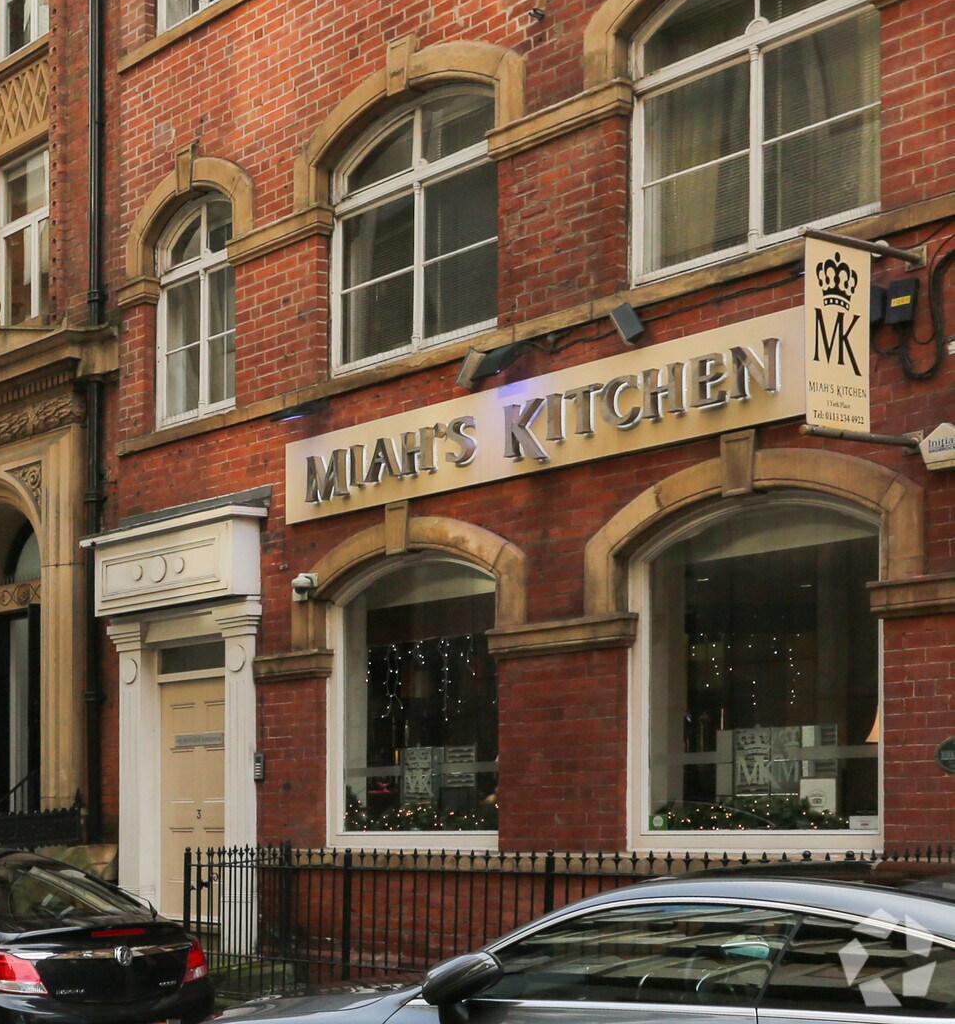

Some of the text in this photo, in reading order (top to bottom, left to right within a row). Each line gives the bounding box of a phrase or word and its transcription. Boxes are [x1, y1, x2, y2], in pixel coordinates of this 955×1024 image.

[813, 307, 862, 377] MK
[836, 385, 867, 398] KITCHEN
[305, 337, 781, 504] MIAH'S KITCHEN
[813, 409, 825, 419] Tel:
[825, 412, 839, 422] 0113
[840, 413, 851, 423] 234
[196, 809, 201, 819] 3
